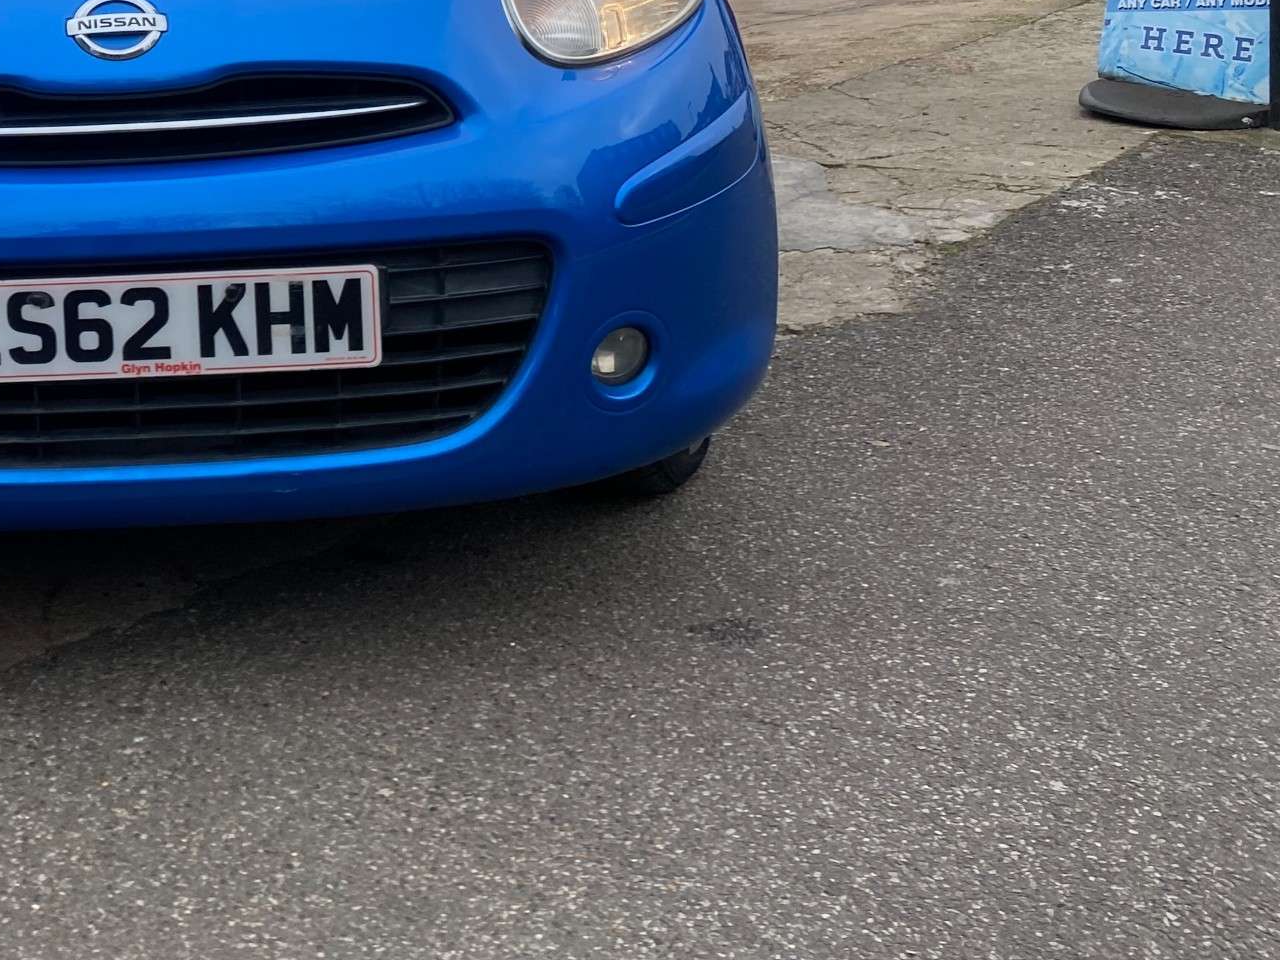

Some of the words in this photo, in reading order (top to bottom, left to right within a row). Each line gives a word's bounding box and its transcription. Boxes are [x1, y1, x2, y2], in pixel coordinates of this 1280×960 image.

[77, 16, 157, 31] NISSAN
[1140, 26, 1256, 62] HERE
[197, 277, 365, 358] KHM
[121, 363, 151, 375] Glyn
[155, 361, 201, 375] Hopkin
